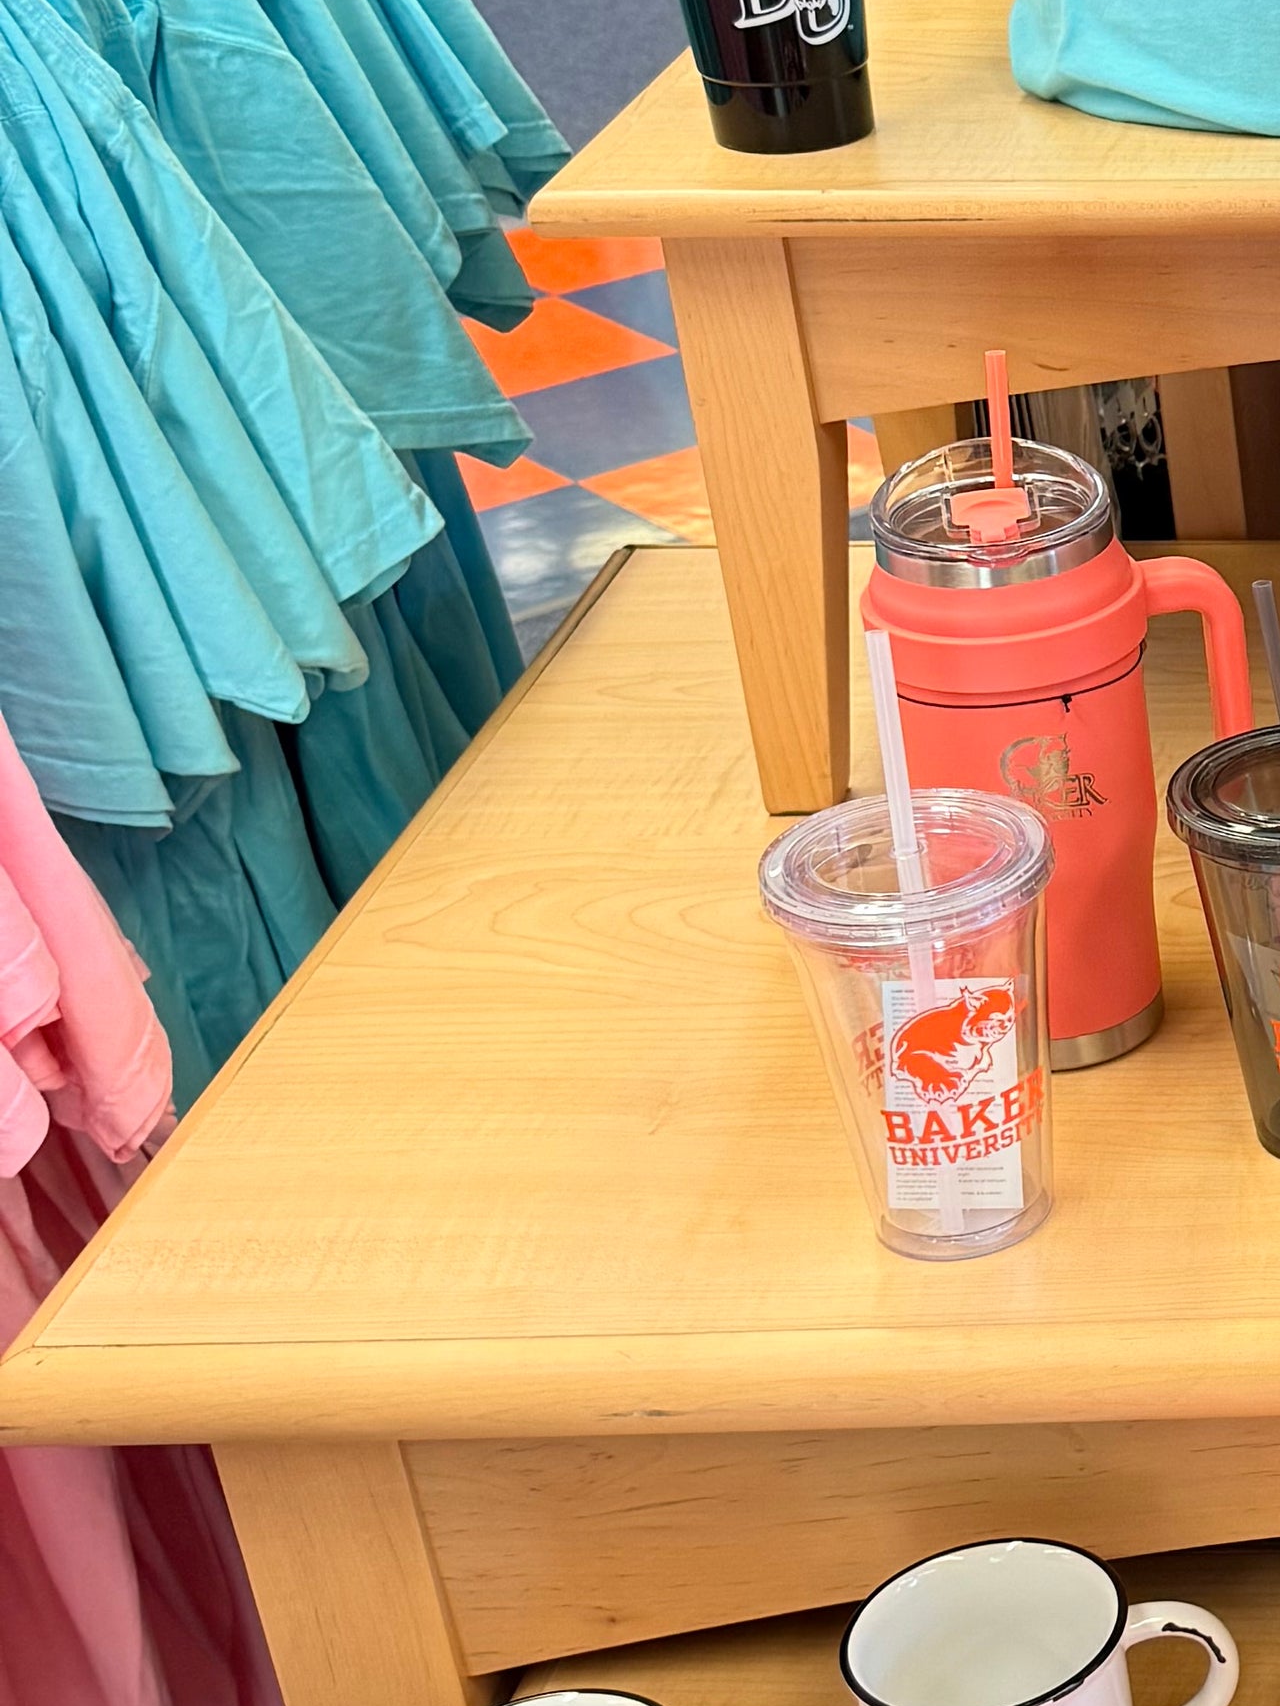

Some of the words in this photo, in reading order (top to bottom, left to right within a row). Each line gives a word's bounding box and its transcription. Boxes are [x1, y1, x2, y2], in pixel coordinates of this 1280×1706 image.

[1030, 771, 1110, 808] KER
[880, 1065, 1044, 1146] BAKER
[887, 1104, 1044, 1168] UNIVERSITY
